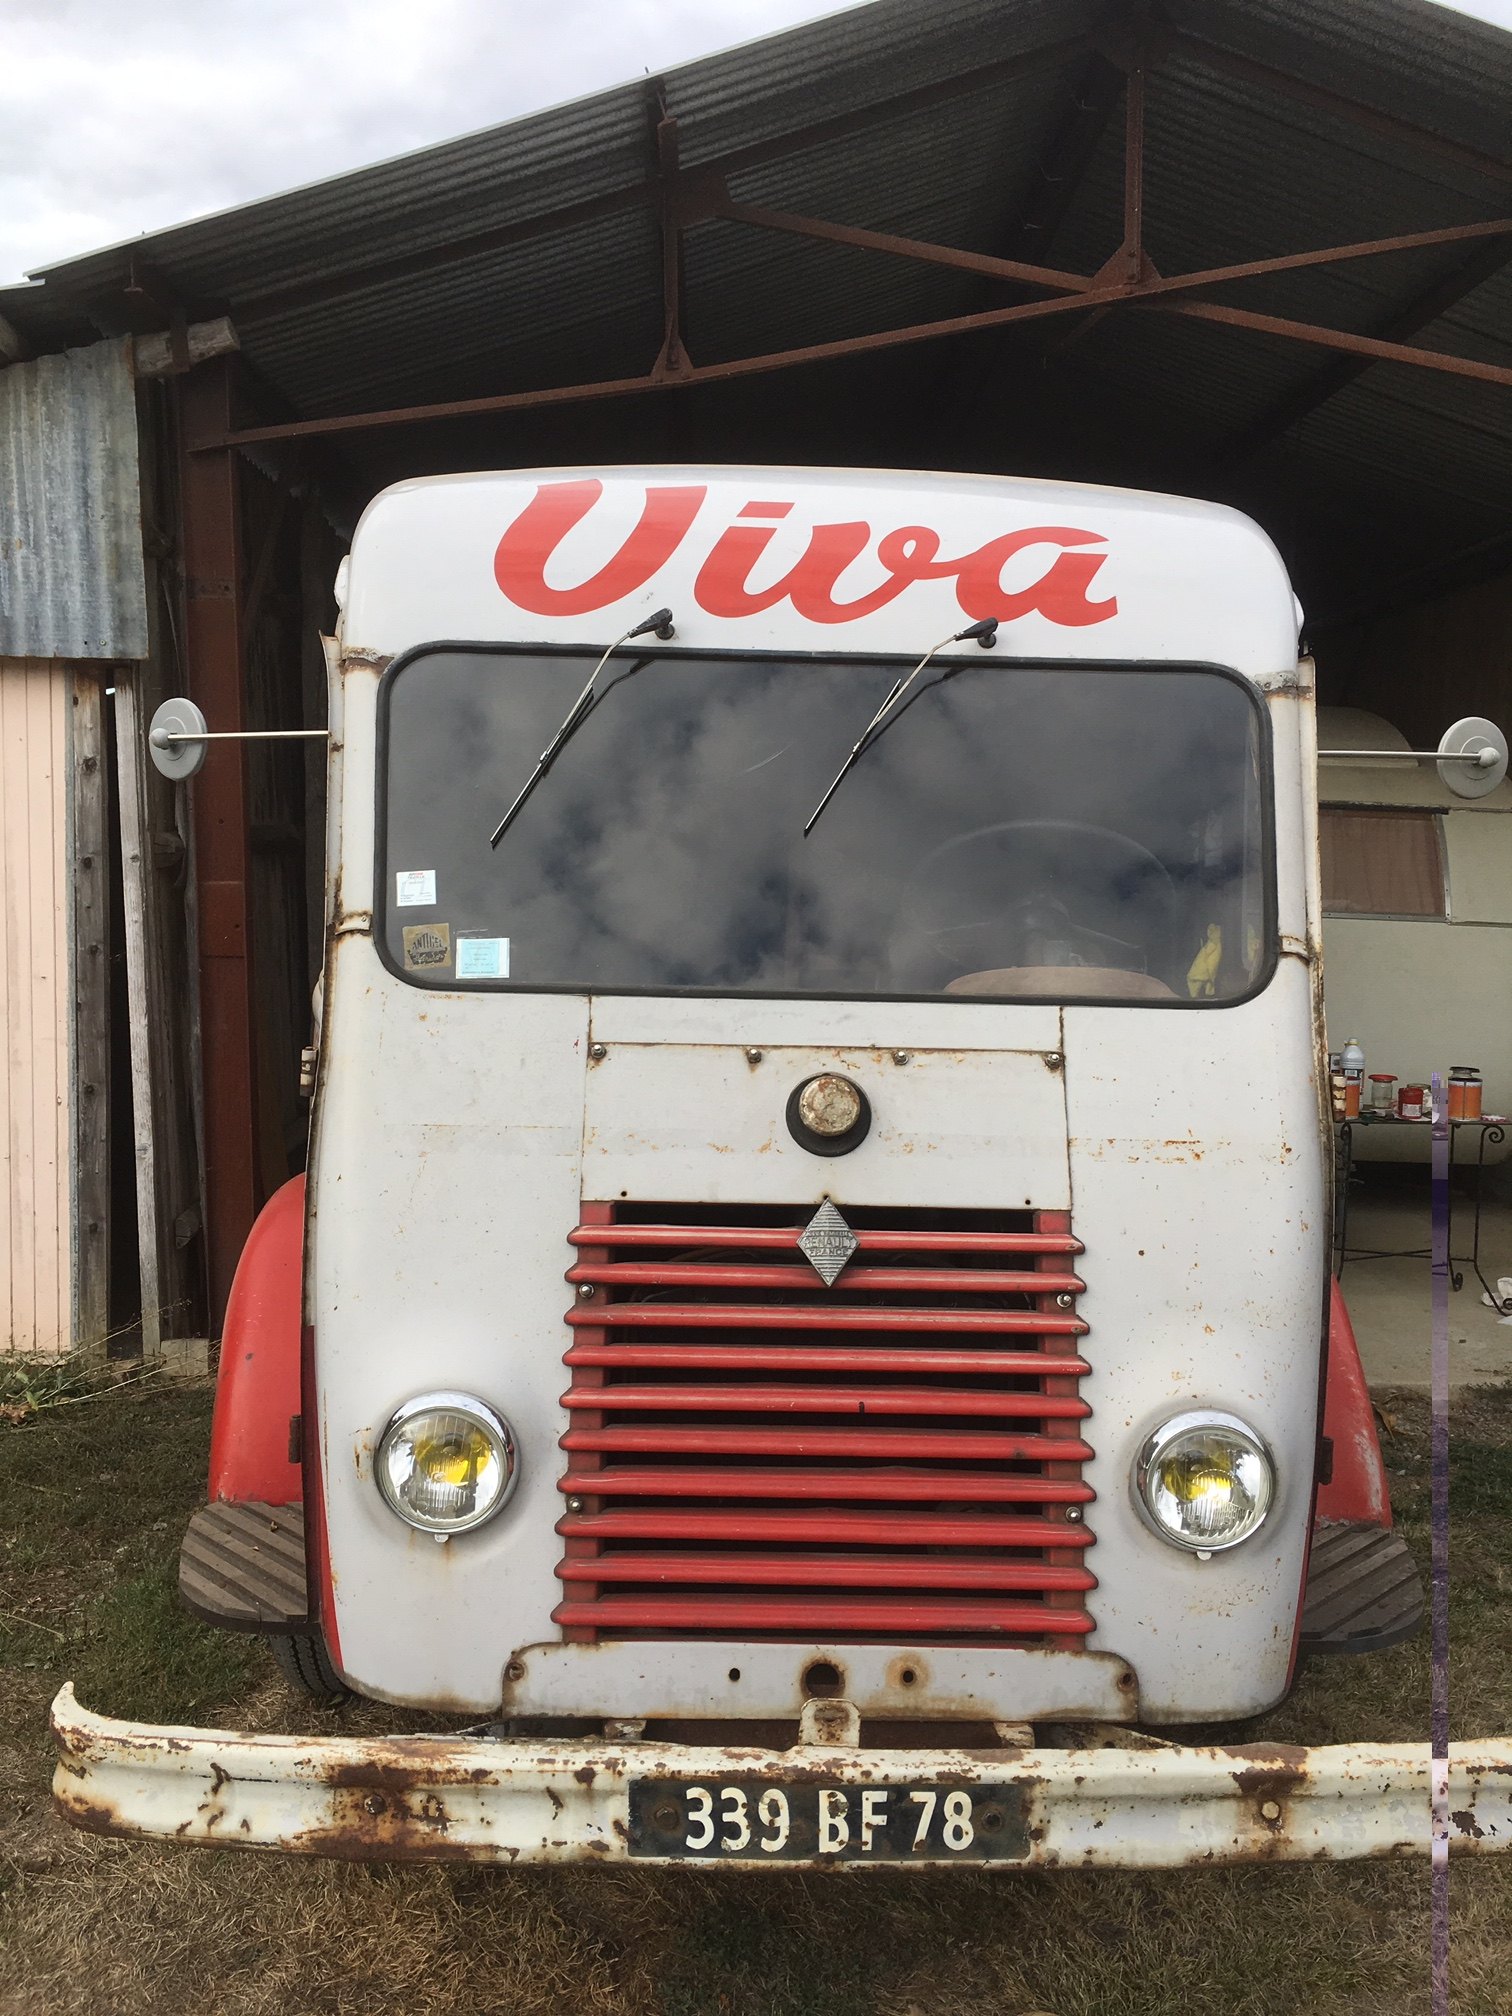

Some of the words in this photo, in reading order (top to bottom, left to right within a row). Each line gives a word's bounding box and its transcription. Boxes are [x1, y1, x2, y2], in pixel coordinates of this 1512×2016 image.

[685, 1786, 790, 1853] 339
[819, 1789, 888, 1853] BF
[909, 1790, 975, 1852] 78
